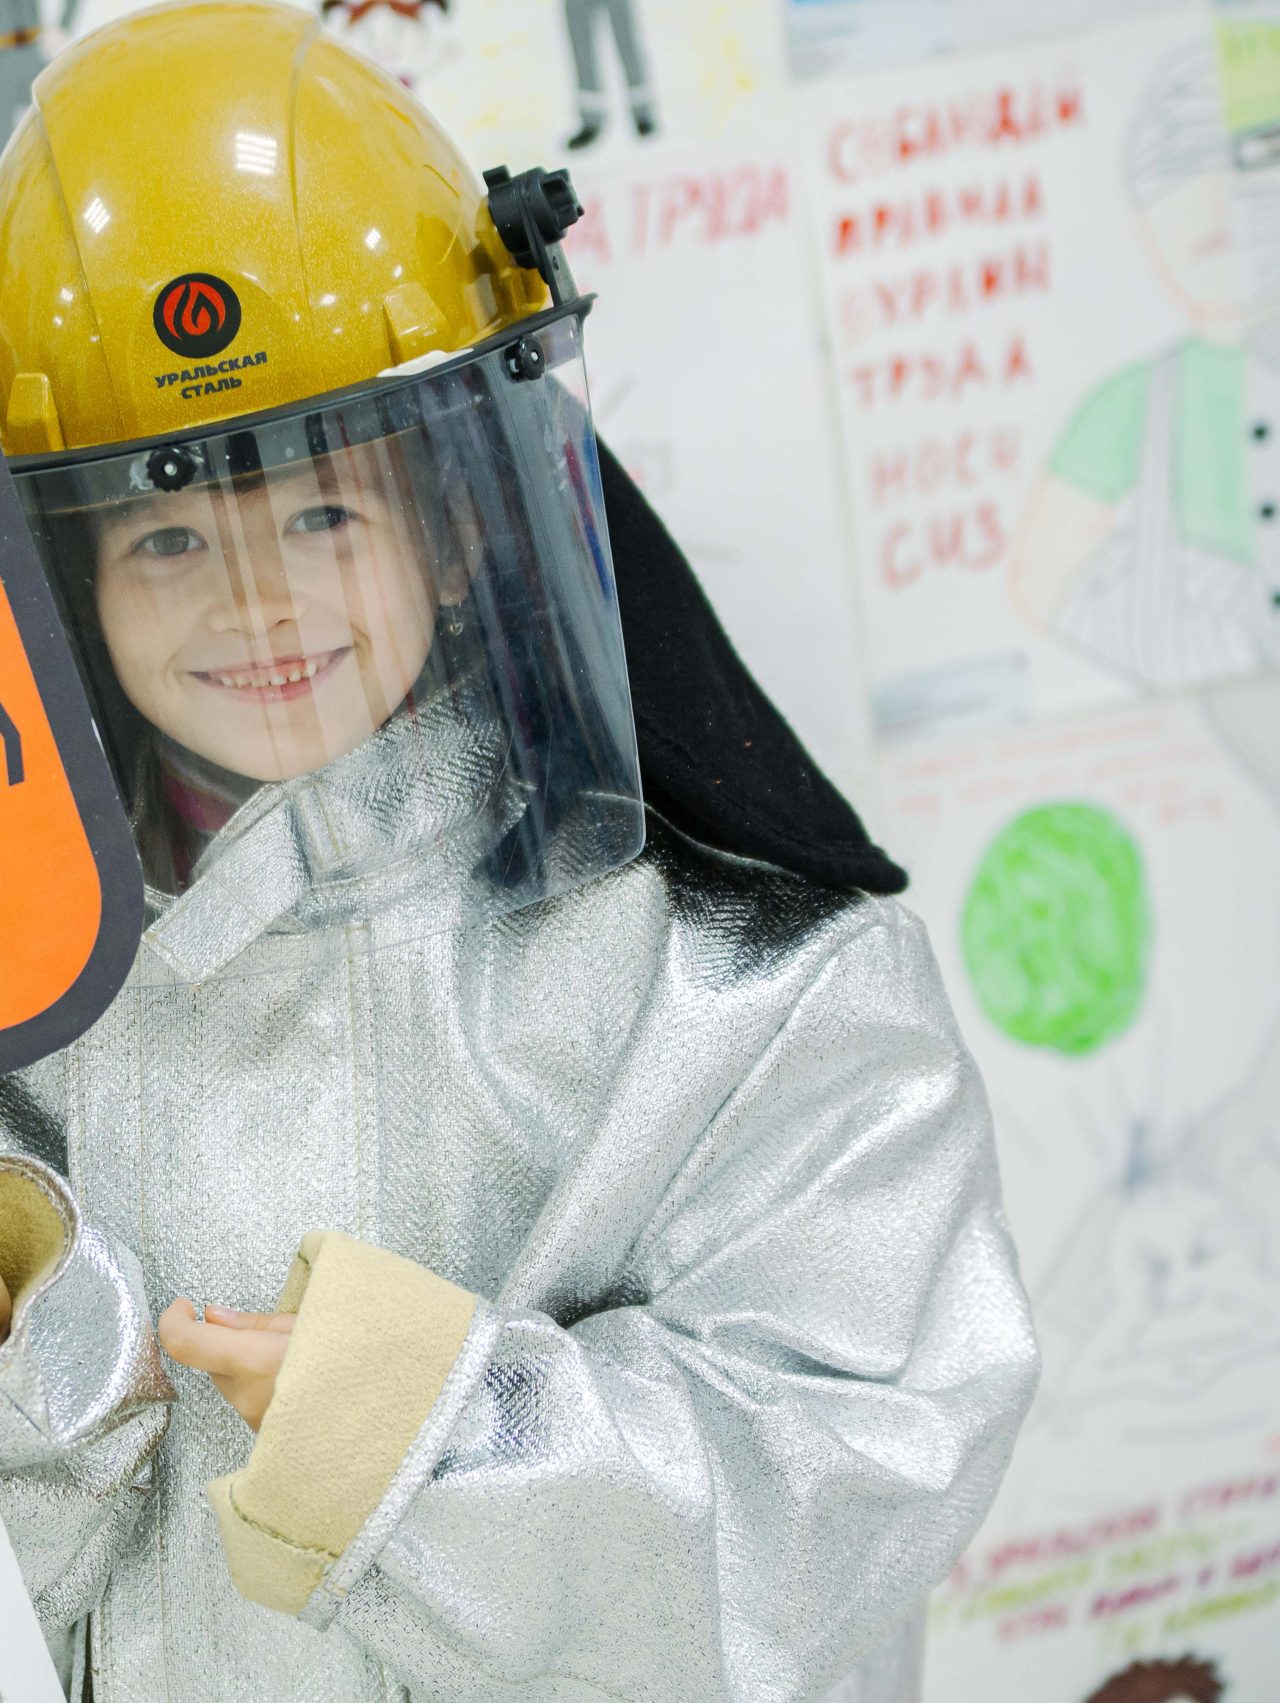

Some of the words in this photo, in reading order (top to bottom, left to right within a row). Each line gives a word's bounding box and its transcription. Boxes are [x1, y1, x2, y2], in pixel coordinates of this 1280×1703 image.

[154, 351, 268, 388] УРАЛЬСКАЯ
[181, 377, 242, 399] СТАЛЬ
[847, 333, 1033, 411] ТРУДА
